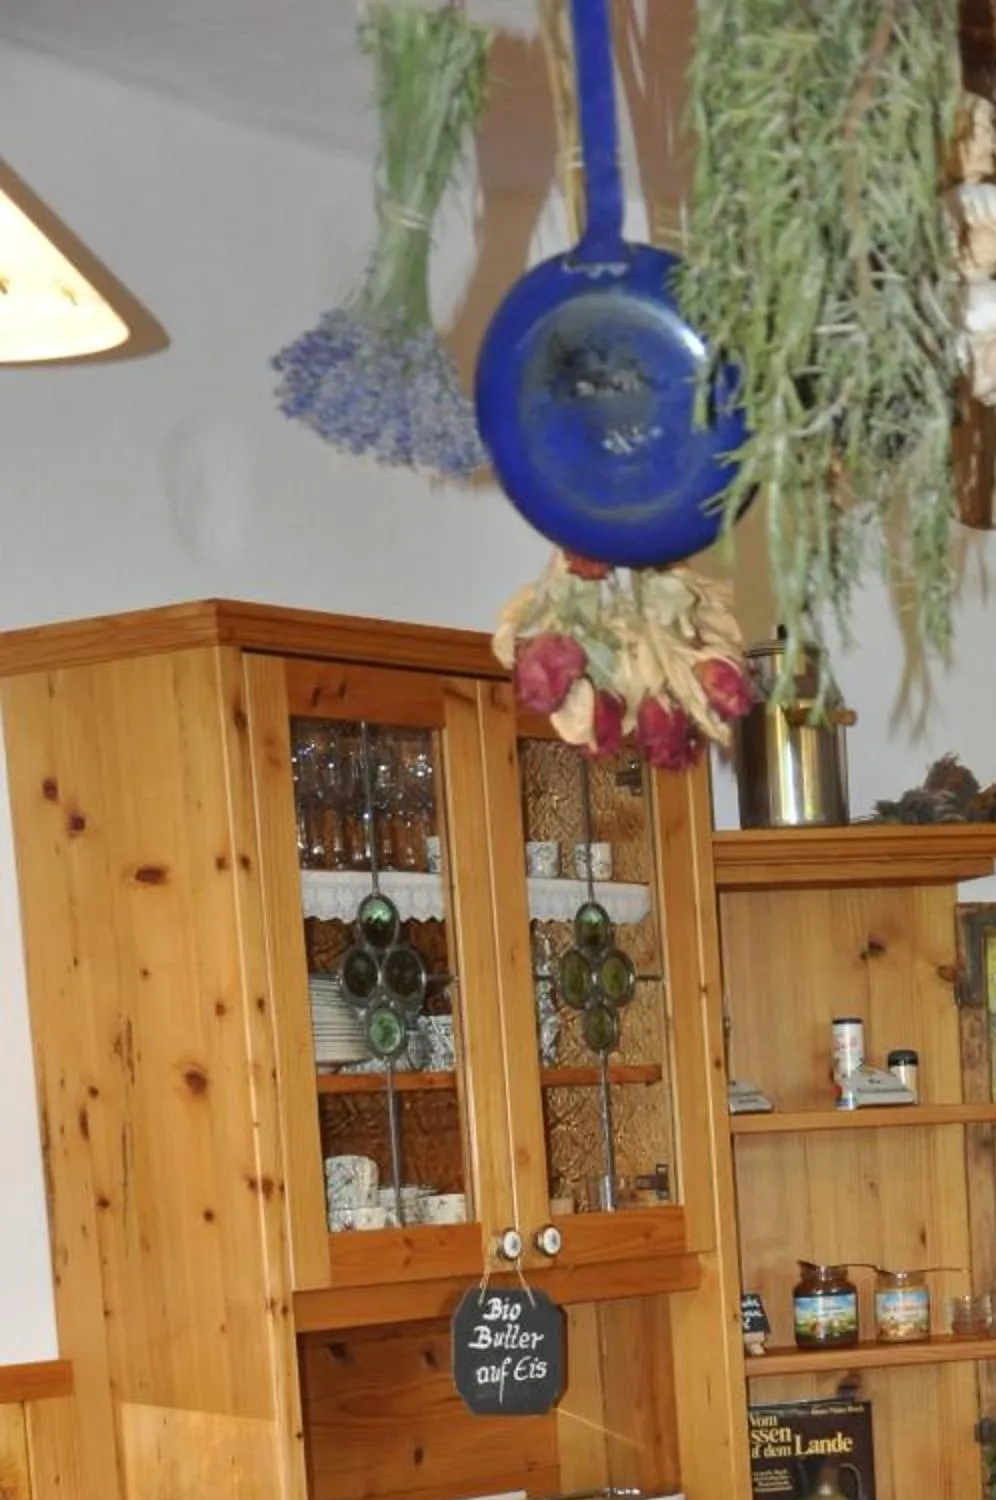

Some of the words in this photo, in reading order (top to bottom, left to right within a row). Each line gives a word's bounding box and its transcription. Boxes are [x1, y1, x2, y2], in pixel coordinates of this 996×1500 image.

[482, 1297, 522, 1321] Bio
[468, 1323, 544, 1349] Butter
[475, 1356, 512, 1404] auf
[513, 1355, 548, 1381] Eis
[751, 1427, 791, 1444] ssen
[795, 1431, 853, 1456] Lande
